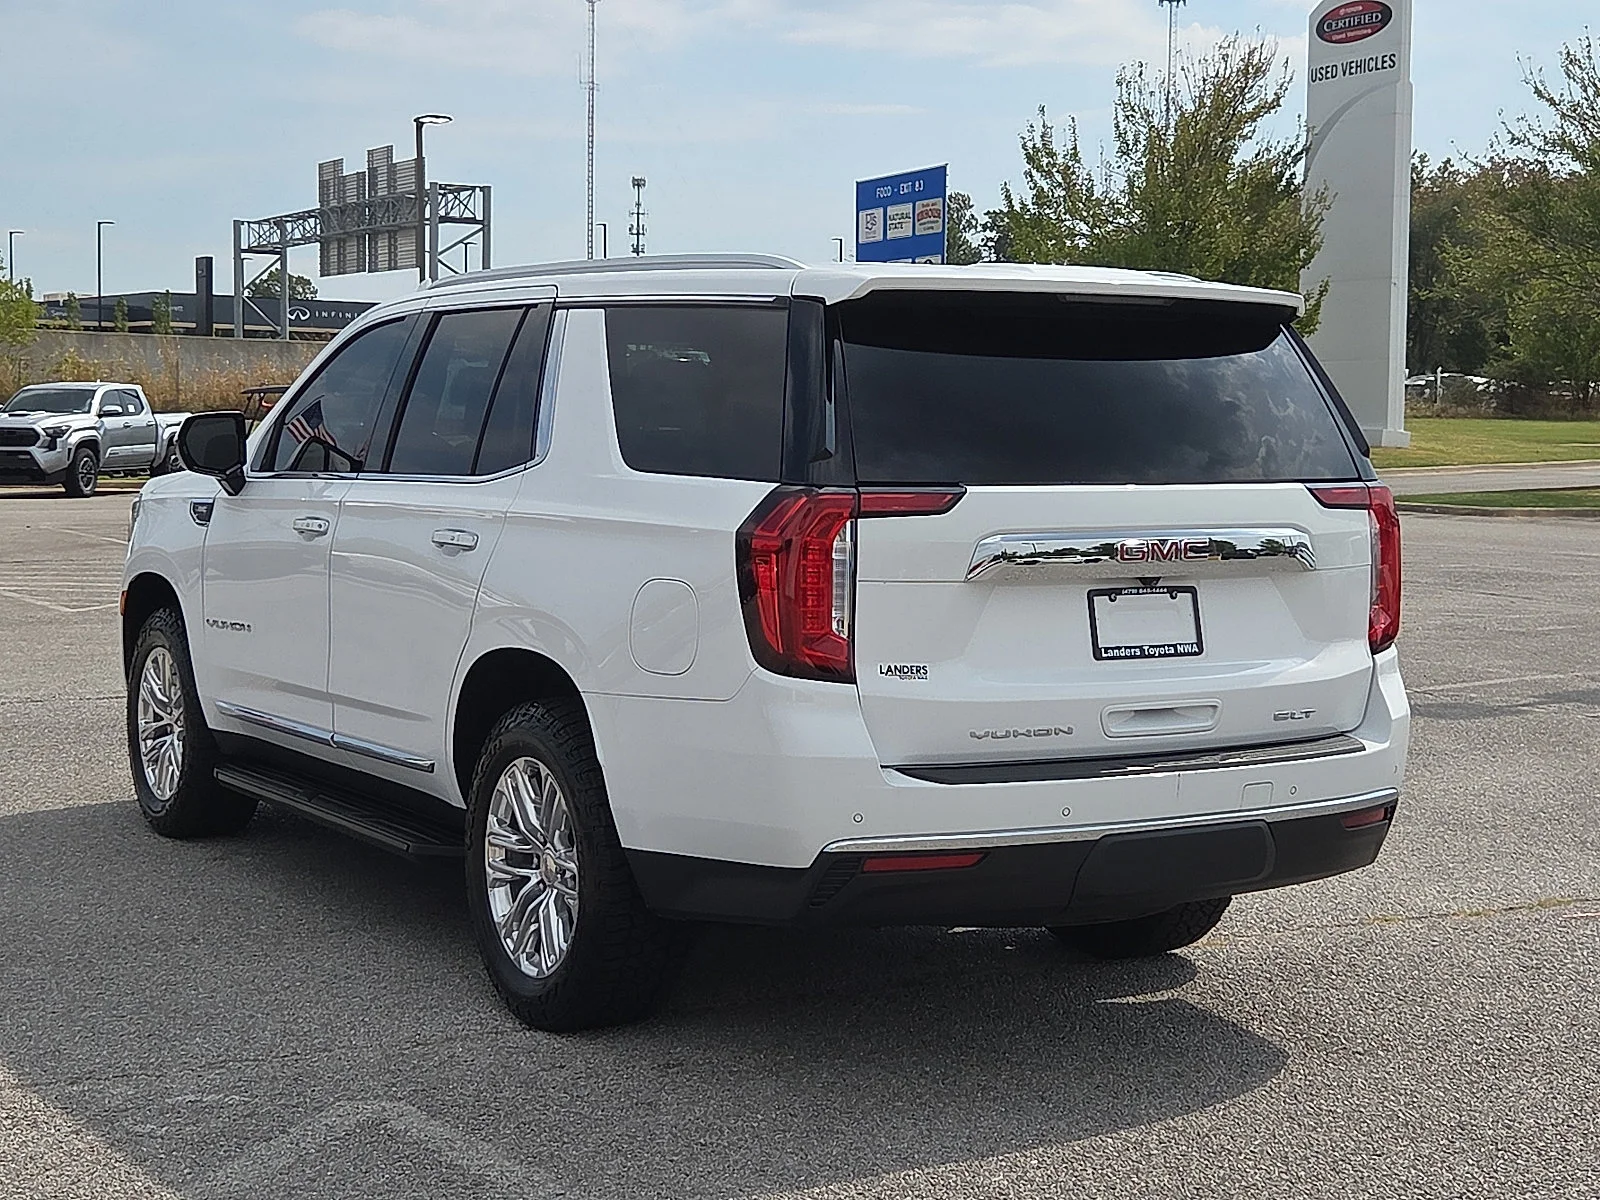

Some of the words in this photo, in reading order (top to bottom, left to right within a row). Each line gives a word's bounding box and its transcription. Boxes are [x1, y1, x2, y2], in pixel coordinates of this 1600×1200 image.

[1323, 12, 1382, 32] CERTIFIED
[1310, 64, 1338, 83] USED
[1341, 53, 1397, 77] VEHICLES
[876, 185, 892, 198] FOOD
[900, 181, 913, 195] EXIT
[888, 211, 912, 222] NATURAL
[888, 221, 904, 232] STATE
[1116, 538, 1210, 563] GMC
[1101, 646, 1141, 658] Landers
[1143, 645, 1175, 658] Toyota
[1177, 643, 1199, 654] NWA
[879, 664, 928, 676] LANDERS
[969, 726, 1074, 740] YUKON
